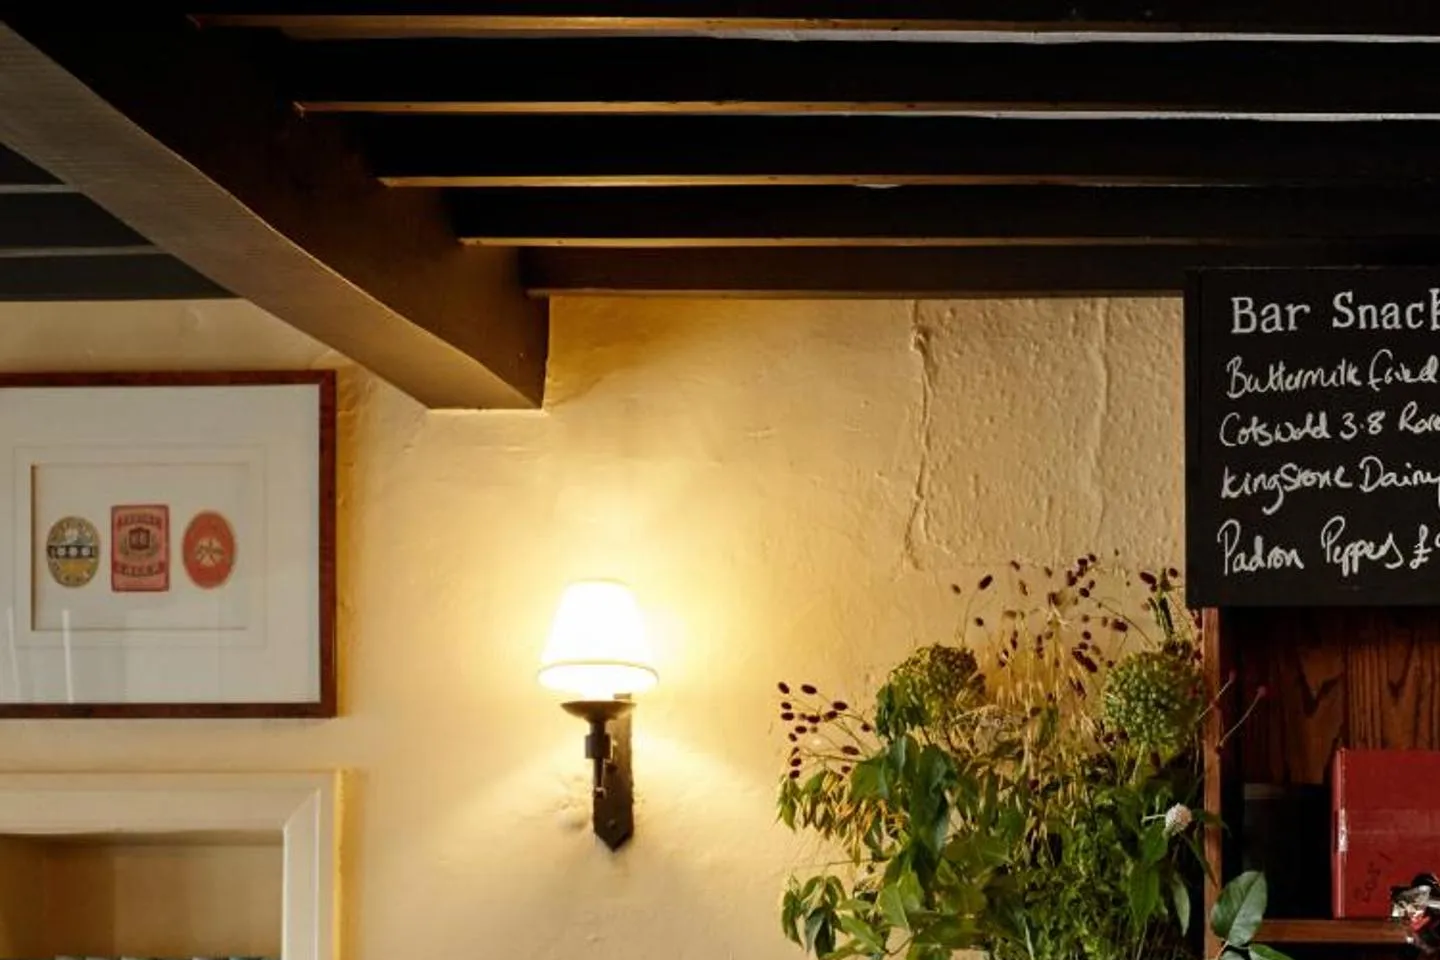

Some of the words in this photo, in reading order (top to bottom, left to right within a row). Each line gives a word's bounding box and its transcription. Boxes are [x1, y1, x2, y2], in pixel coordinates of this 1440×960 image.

[1232, 297, 1310, 333] Bar
[1227, 356, 1362, 398] Buttermilk
[1220, 412, 1331, 446] Cotswold
[1340, 411, 1385, 440] 3.8
[1217, 519, 1304, 575] Padron
